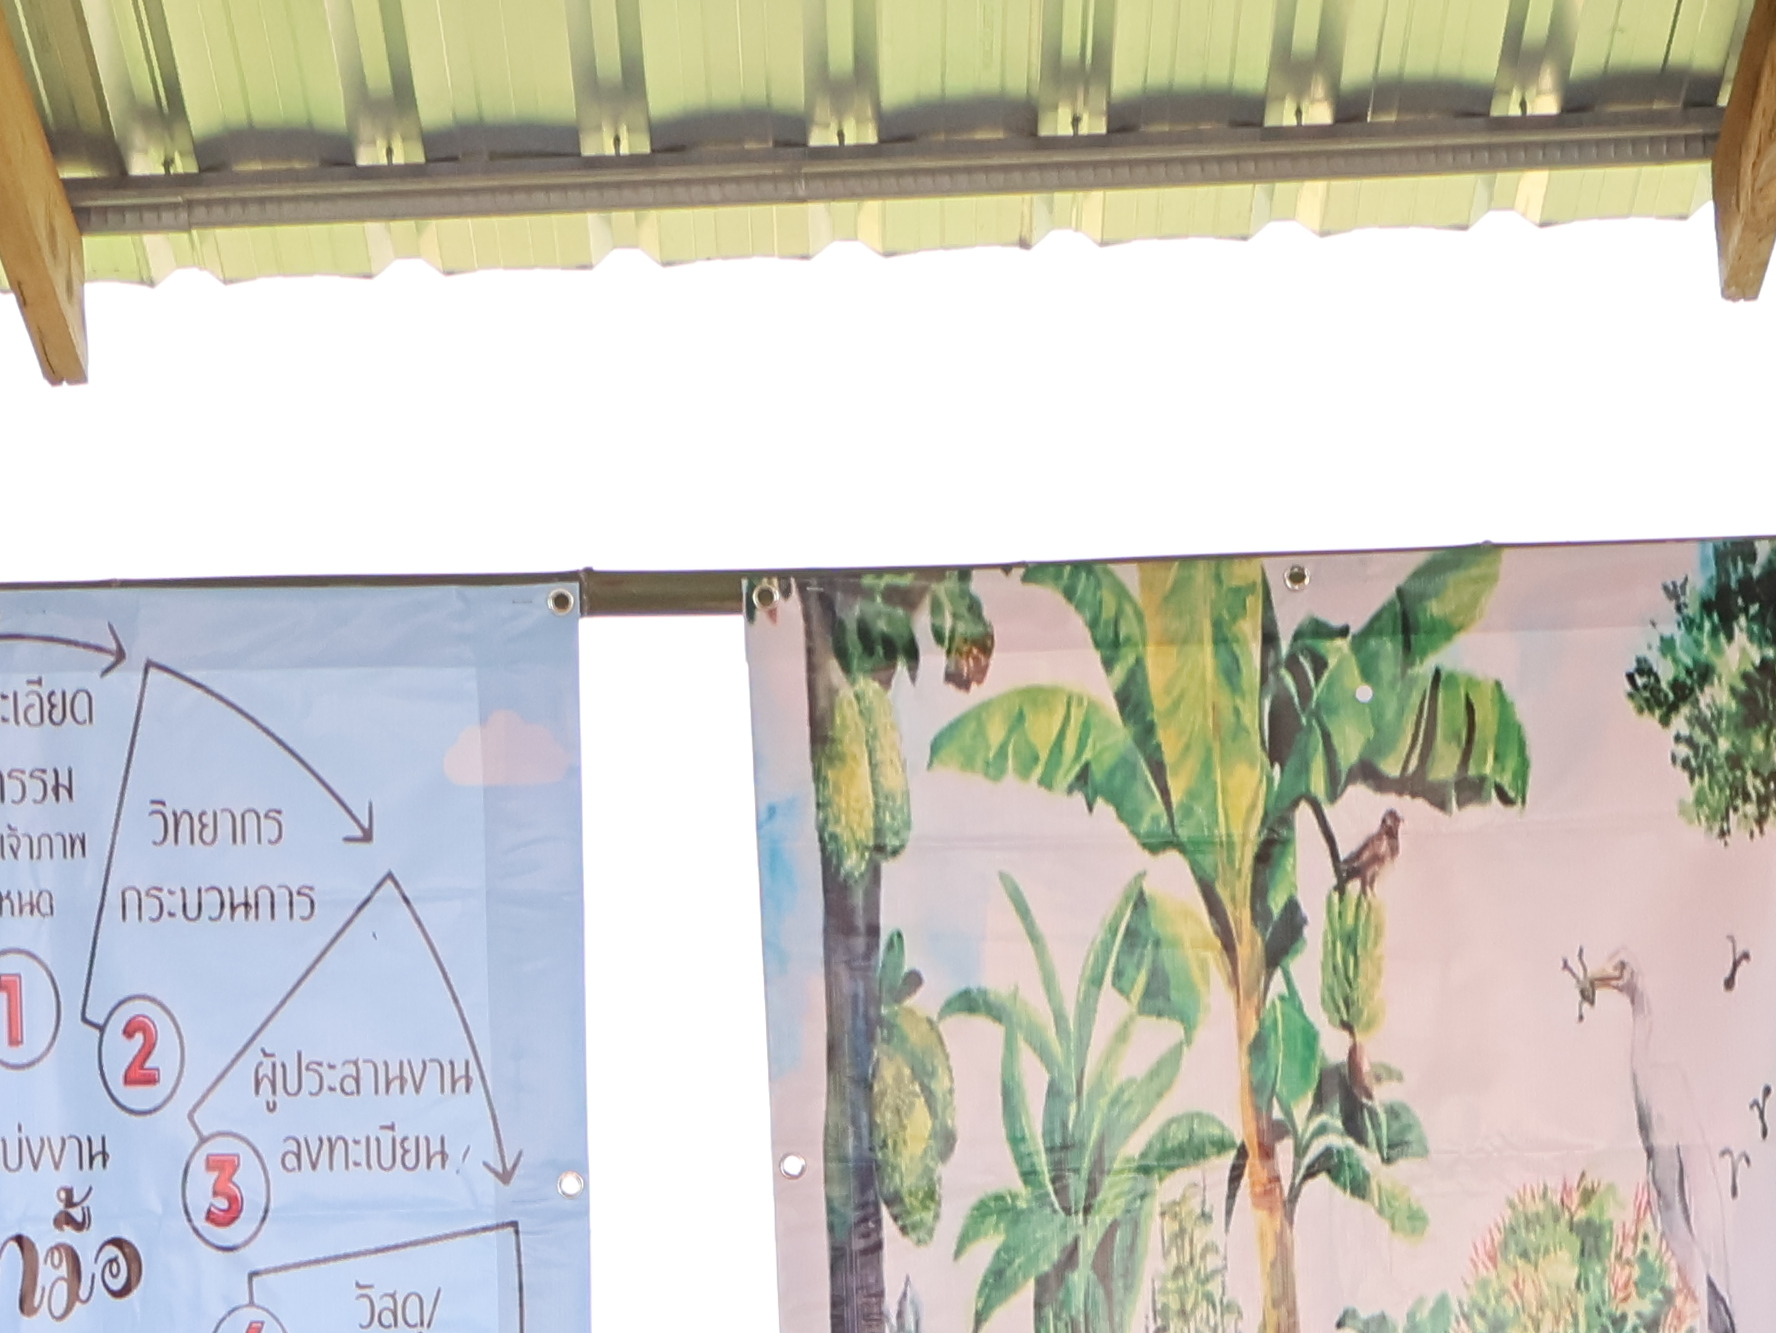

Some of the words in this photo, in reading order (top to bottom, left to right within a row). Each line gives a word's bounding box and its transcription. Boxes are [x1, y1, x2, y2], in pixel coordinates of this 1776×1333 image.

[148, 800, 284, 848] วิทยากร
[119, 883, 316, 924] กระบวนการ
[122, 1014, 161, 1088] 2
[253, 1047, 474, 1114] ผู้ประสานงาน
[280, 1121, 449, 1173] ลงทะเบียน
[203, 1153, 244, 1229] 3
